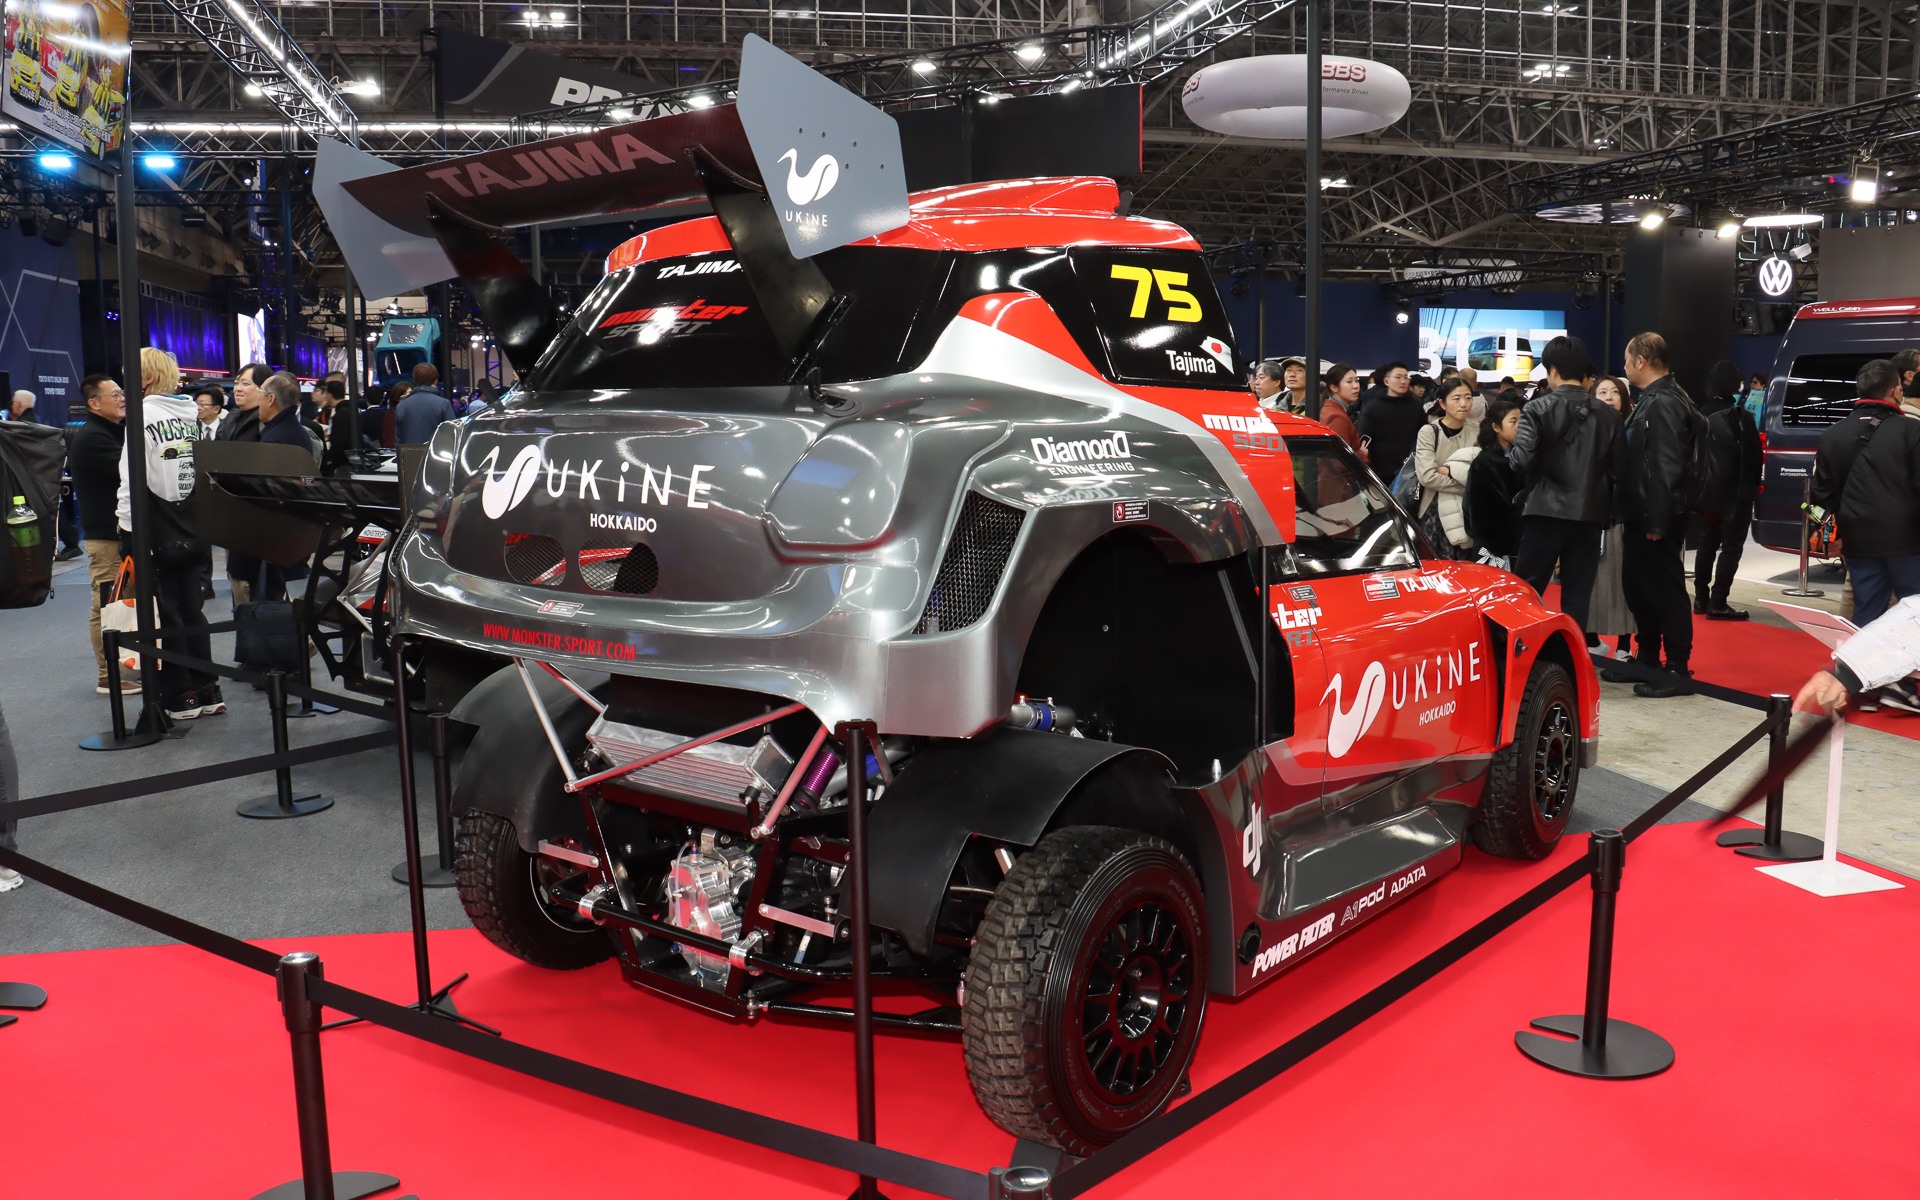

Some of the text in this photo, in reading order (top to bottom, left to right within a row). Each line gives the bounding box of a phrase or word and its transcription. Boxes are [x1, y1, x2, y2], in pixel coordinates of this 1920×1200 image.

[426, 134, 676, 198] TAJIMA
[656, 260, 744, 279] TAJIMA
[1111, 264, 1202, 323] 75
[1166, 350, 1217, 376] Tajima
[1233, 433, 1288, 452] SPO
[1050, 461, 1135, 477] ENGINEERING
[590, 513, 657, 533] HOKKAIDO
[1401, 574, 1454, 593] TAJIMA
[483, 622, 637, 661] WWW.MONSTER-SPORT.COM
[1419, 700, 1457, 726] HOKKAIDO
[1252, 933, 1300, 979] POWER
[1298, 912, 1336, 951] FILTER
[1390, 865, 1427, 897] ADATA
